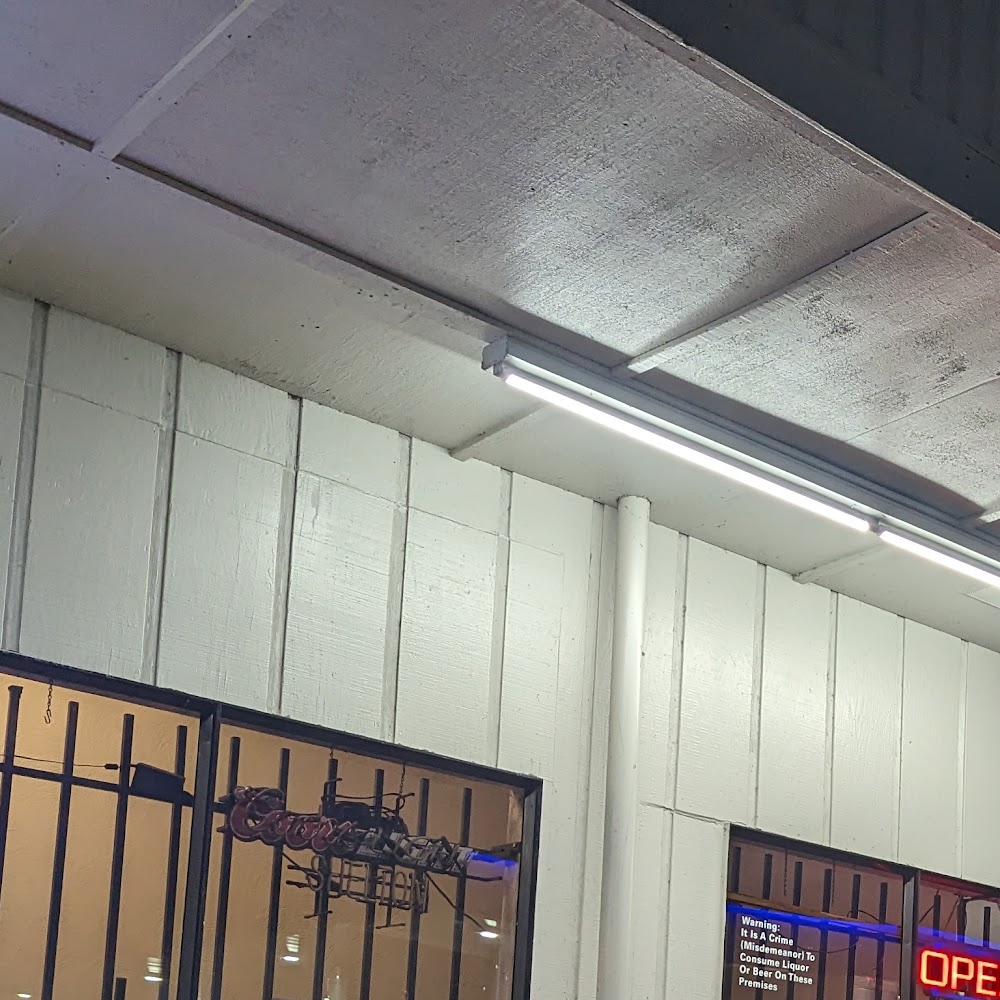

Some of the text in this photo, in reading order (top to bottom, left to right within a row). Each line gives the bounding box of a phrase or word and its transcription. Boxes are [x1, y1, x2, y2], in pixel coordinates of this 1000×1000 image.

[741, 916, 780, 932] Warning:
[741, 928, 794, 946] It Is A Crime
[740, 940, 815, 961] (Misdemeanor) To
[740, 953, 810, 972] Consume Liquor
[739, 965, 813, 984] Or Beer On These
[738, 977, 778, 991] Premises
